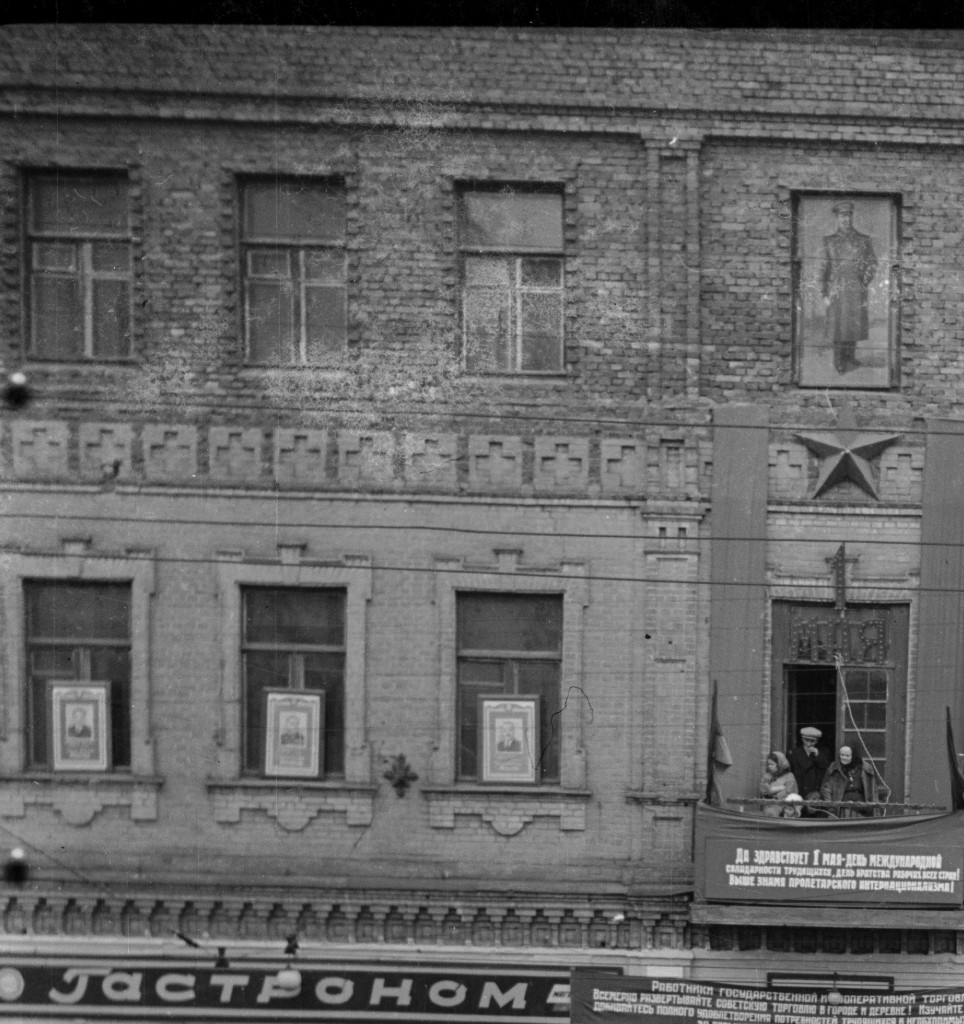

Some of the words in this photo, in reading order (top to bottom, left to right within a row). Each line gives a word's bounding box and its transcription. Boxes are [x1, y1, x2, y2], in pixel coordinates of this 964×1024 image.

[735, 848, 750, 864] ДА
[754, 850, 809, 865] ЗДРАВСТВУЕТ
[869, 853, 942, 870] МЕЖДУНАРОДНОЙ
[726, 864, 781, 875] СОЛИДАРНОСТИ
[835, 868, 855, 878] ДЕНЬ
[856, 869, 891, 878] БРАТСТВА
[892, 870, 922, 879] РАБОЧИХ
[922, 871, 937, 880] ВСЕХ
[729, 874, 755, 886] ВЫШЕ
[756, 876, 786, 887] ЗНАМЯ
[788, 877, 857, 890] ПРОЛЕТАРСКОГО
[859, 880, 954, 893] ИНТЕРНАЦИОНАЛИЗМА!
[593, 988, 638, 1002] ВСЕМЕРНО
[640, 993, 713, 1007] РАЗВЕРТЫВАЙТЕ
[716, 998, 768, 1011] СОВЕТСКУЮ
[771, 1002, 817, 1014] ТОРГОВЛЮ
[819, 1005, 825, 1015] В
[827, 1005, 858, 1016] ГОРОДЕ
[861, 1006, 867, 1016] И
[918, 1003, 963, 1015] ИЗУЧАЙТЕ
[651, 980, 714, 995] РАБОТНИКИ
[719, 988, 818, 1003] ГОСУДАРСТВЕННОЙ
[829, 993, 916, 1004] ОПЕРАТИВНОЙ
[593, 1001, 654, 1015] ДОБИВАЙТЕСЬ
[656, 1005, 695, 1017] ПОЛНОГО
[697, 1008, 771, 1023] УДОВЛЕТВОРЕНИЯ
